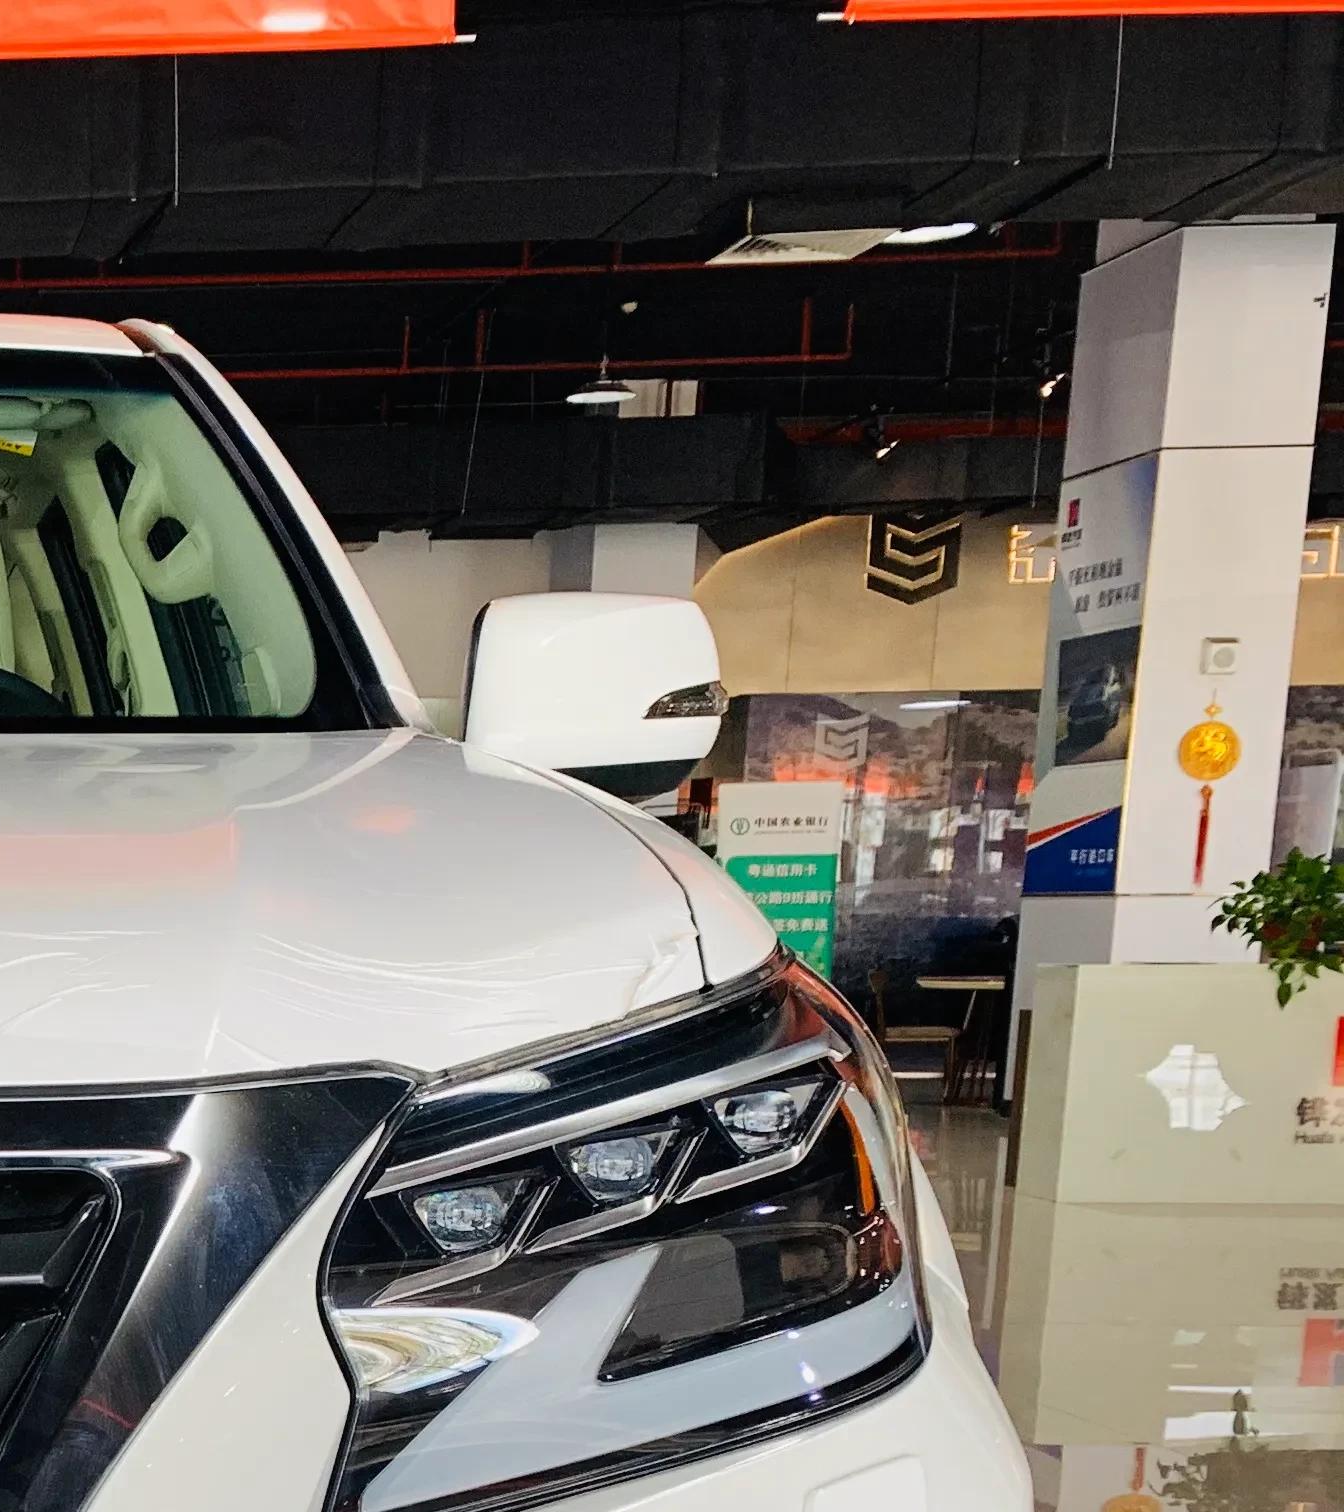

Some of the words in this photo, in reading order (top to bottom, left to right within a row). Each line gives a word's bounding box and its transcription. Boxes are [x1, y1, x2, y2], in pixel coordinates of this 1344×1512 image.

[754, 815, 829, 828] 中国农业银行
